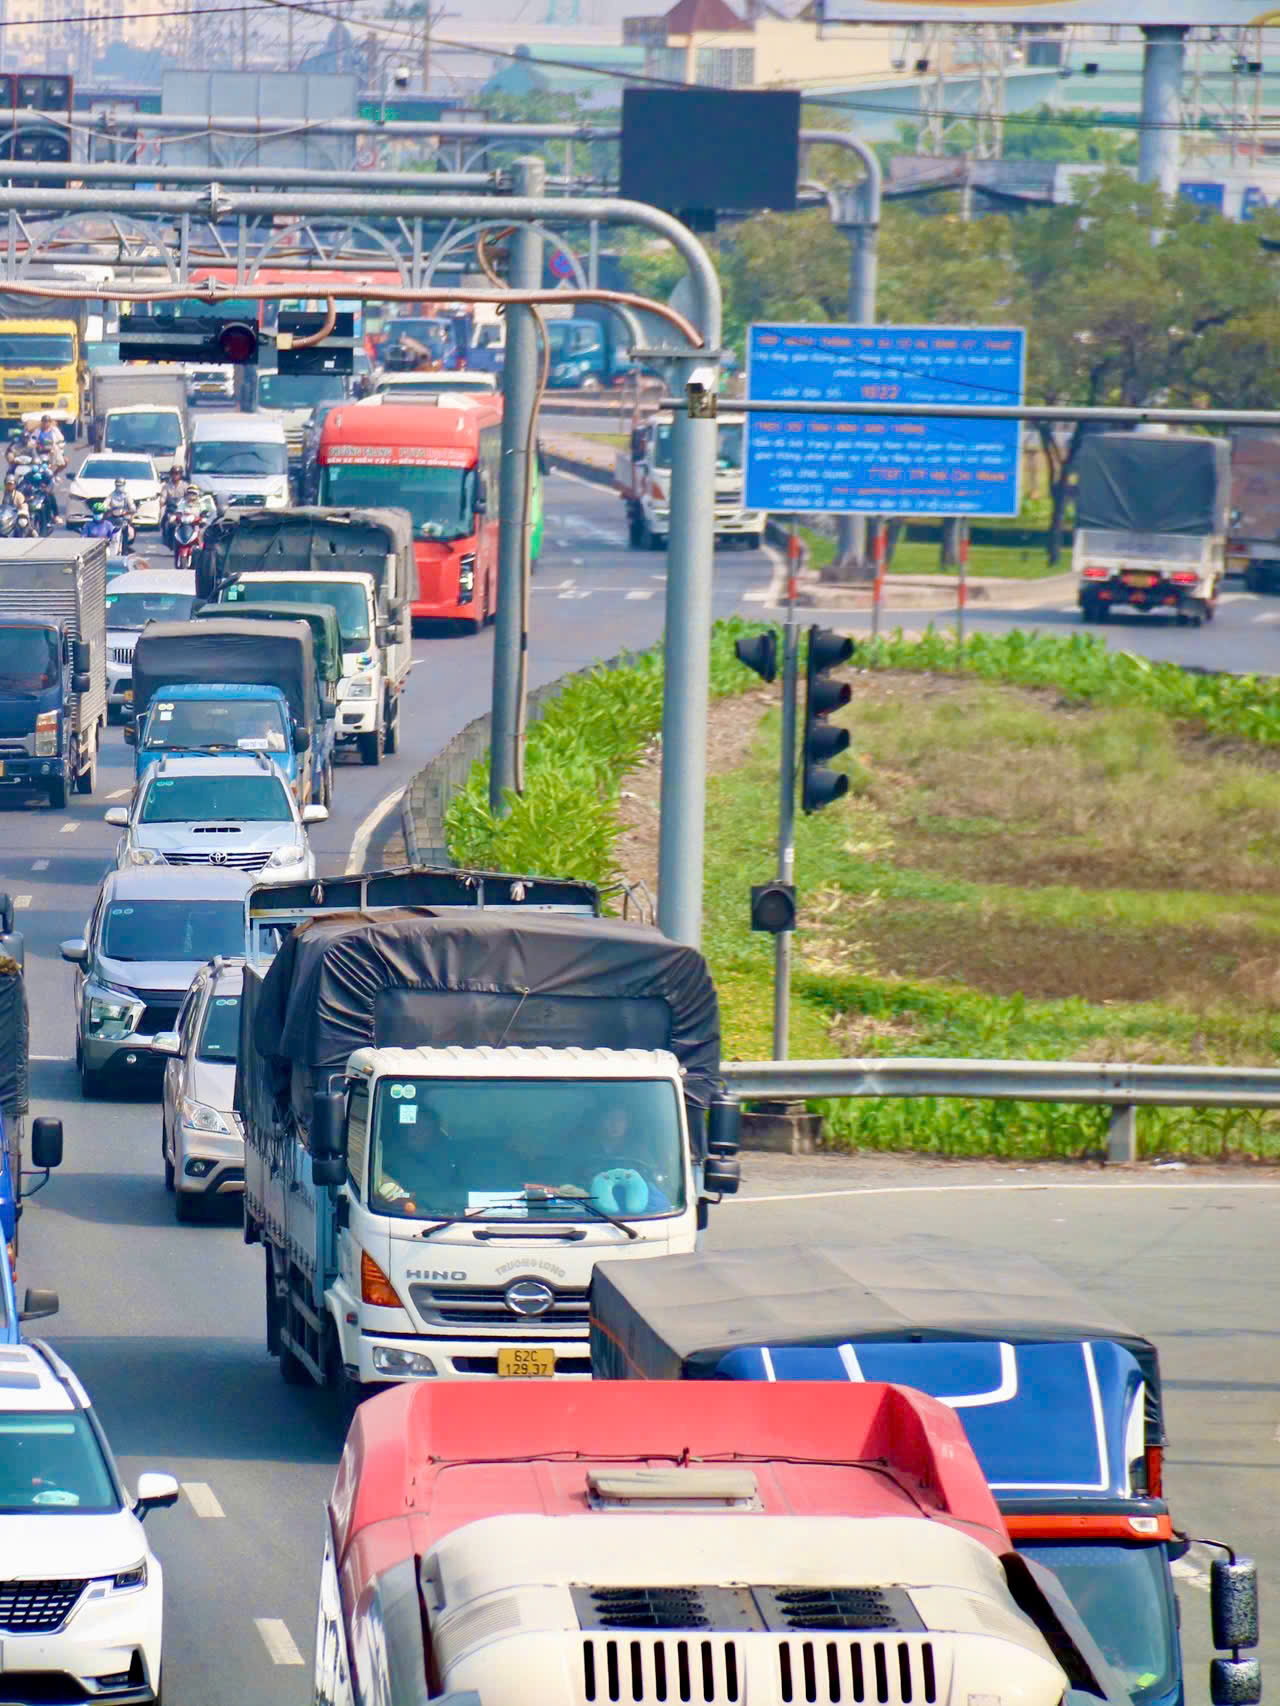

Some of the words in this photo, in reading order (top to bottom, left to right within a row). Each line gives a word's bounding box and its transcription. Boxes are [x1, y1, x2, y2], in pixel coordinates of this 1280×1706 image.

[406, 1269, 468, 1280] HINO
[514, 1350, 538, 1363] 62C
[505, 1362, 548, 1376] 129.37
